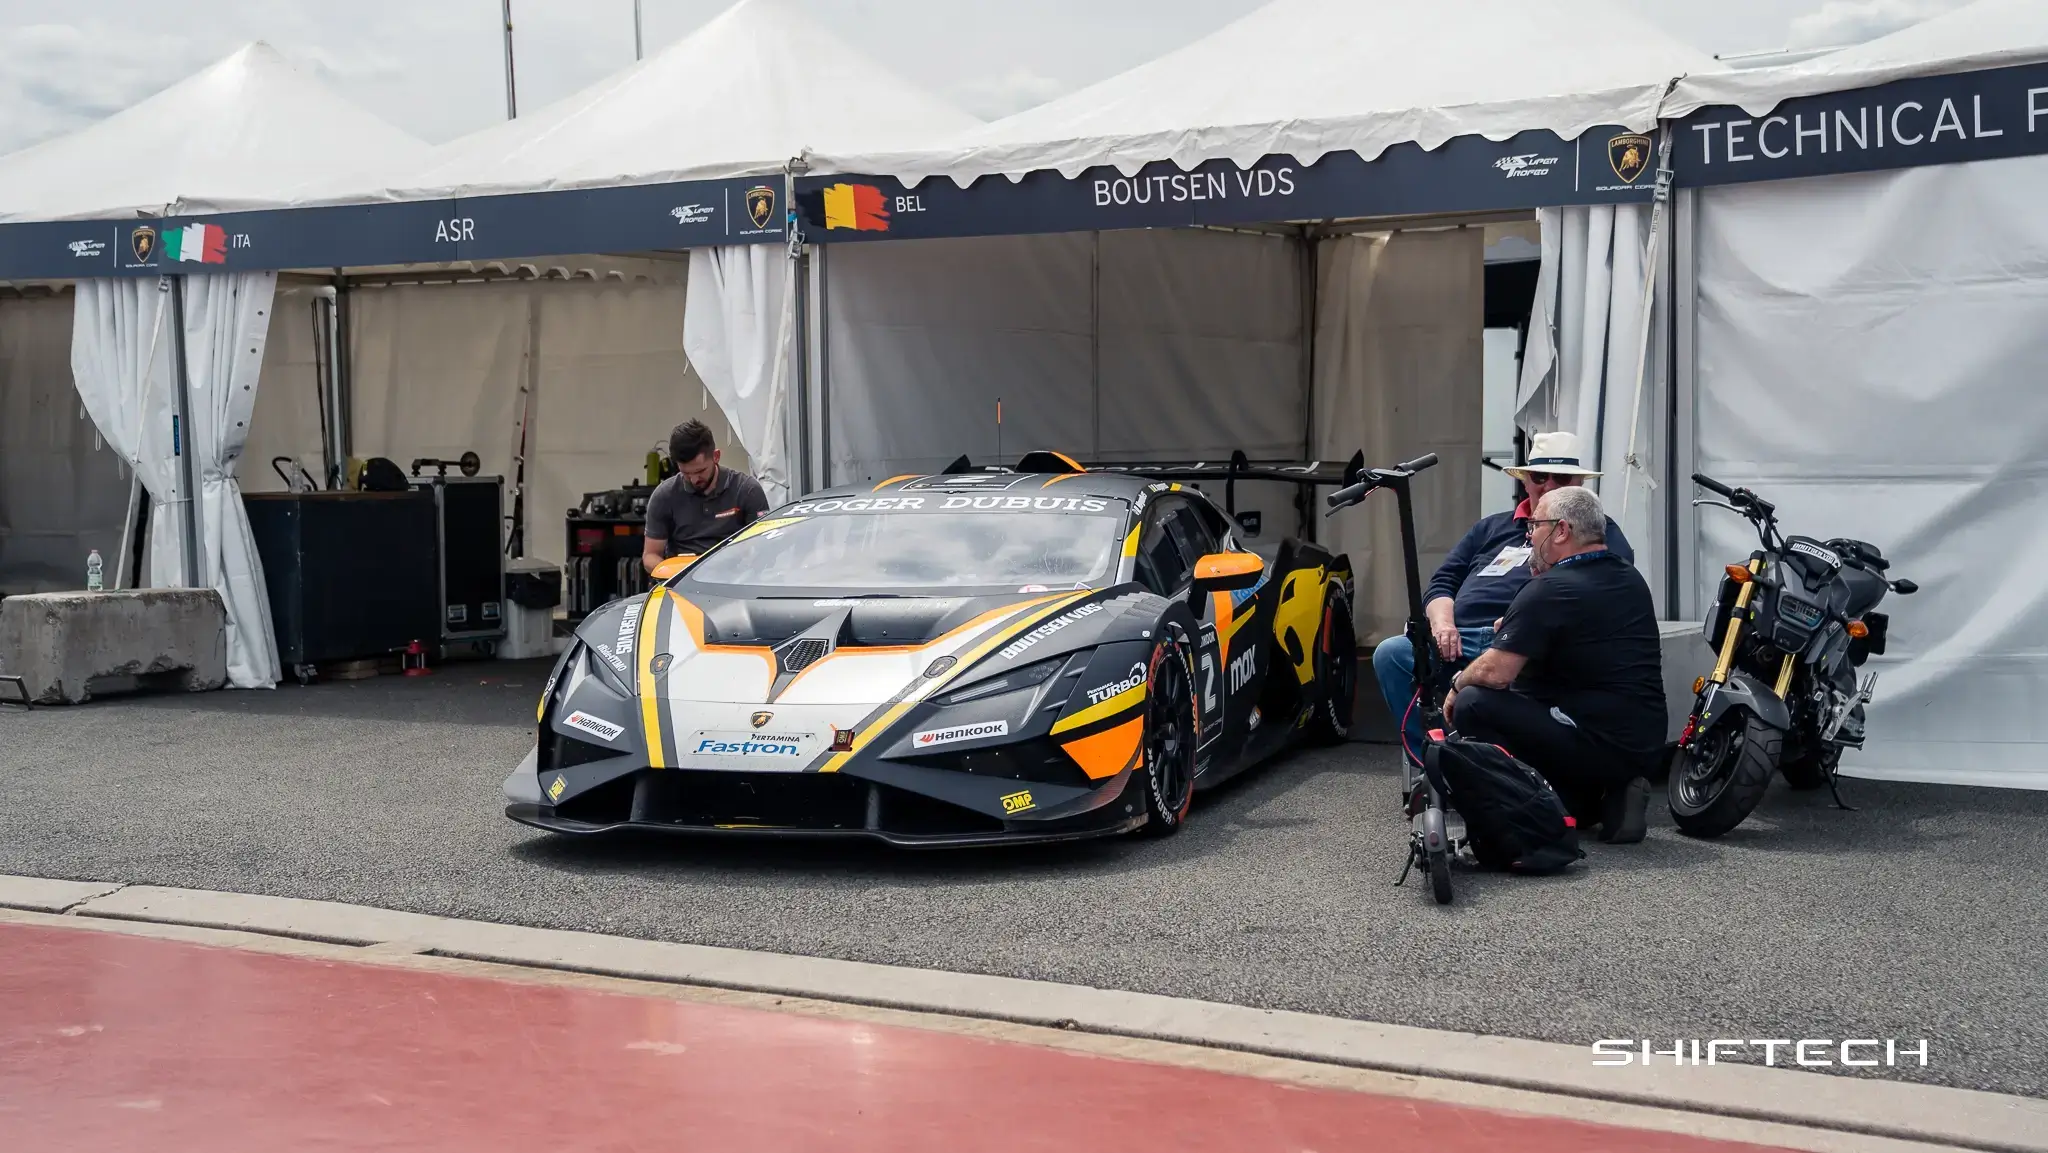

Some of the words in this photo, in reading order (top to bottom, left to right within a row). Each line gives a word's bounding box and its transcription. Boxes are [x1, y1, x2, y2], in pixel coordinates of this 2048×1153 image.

[1692, 94, 2003, 165] TECHNICAL
[1094, 172, 1226, 206] BOUTSEN
[1235, 168, 1295, 197] VDS
[895, 195, 927, 213] BEL
[232, 233, 251, 249] ITA
[435, 217, 475, 243] ASR
[782, 496, 925, 516] ROGER
[939, 496, 1108, 512] DUBUIS
[999, 614, 1075, 660] BOUTSEN
[1066, 602, 1104, 620] VDS
[1230, 643, 1256, 696] max
[1088, 674, 1142, 704] TURBO
[1201, 652, 1217, 714] 2
[698, 740, 798, 755] Fastron
[750, 734, 801, 743] PERTAMINA
[1002, 792, 1033, 811] OMP
